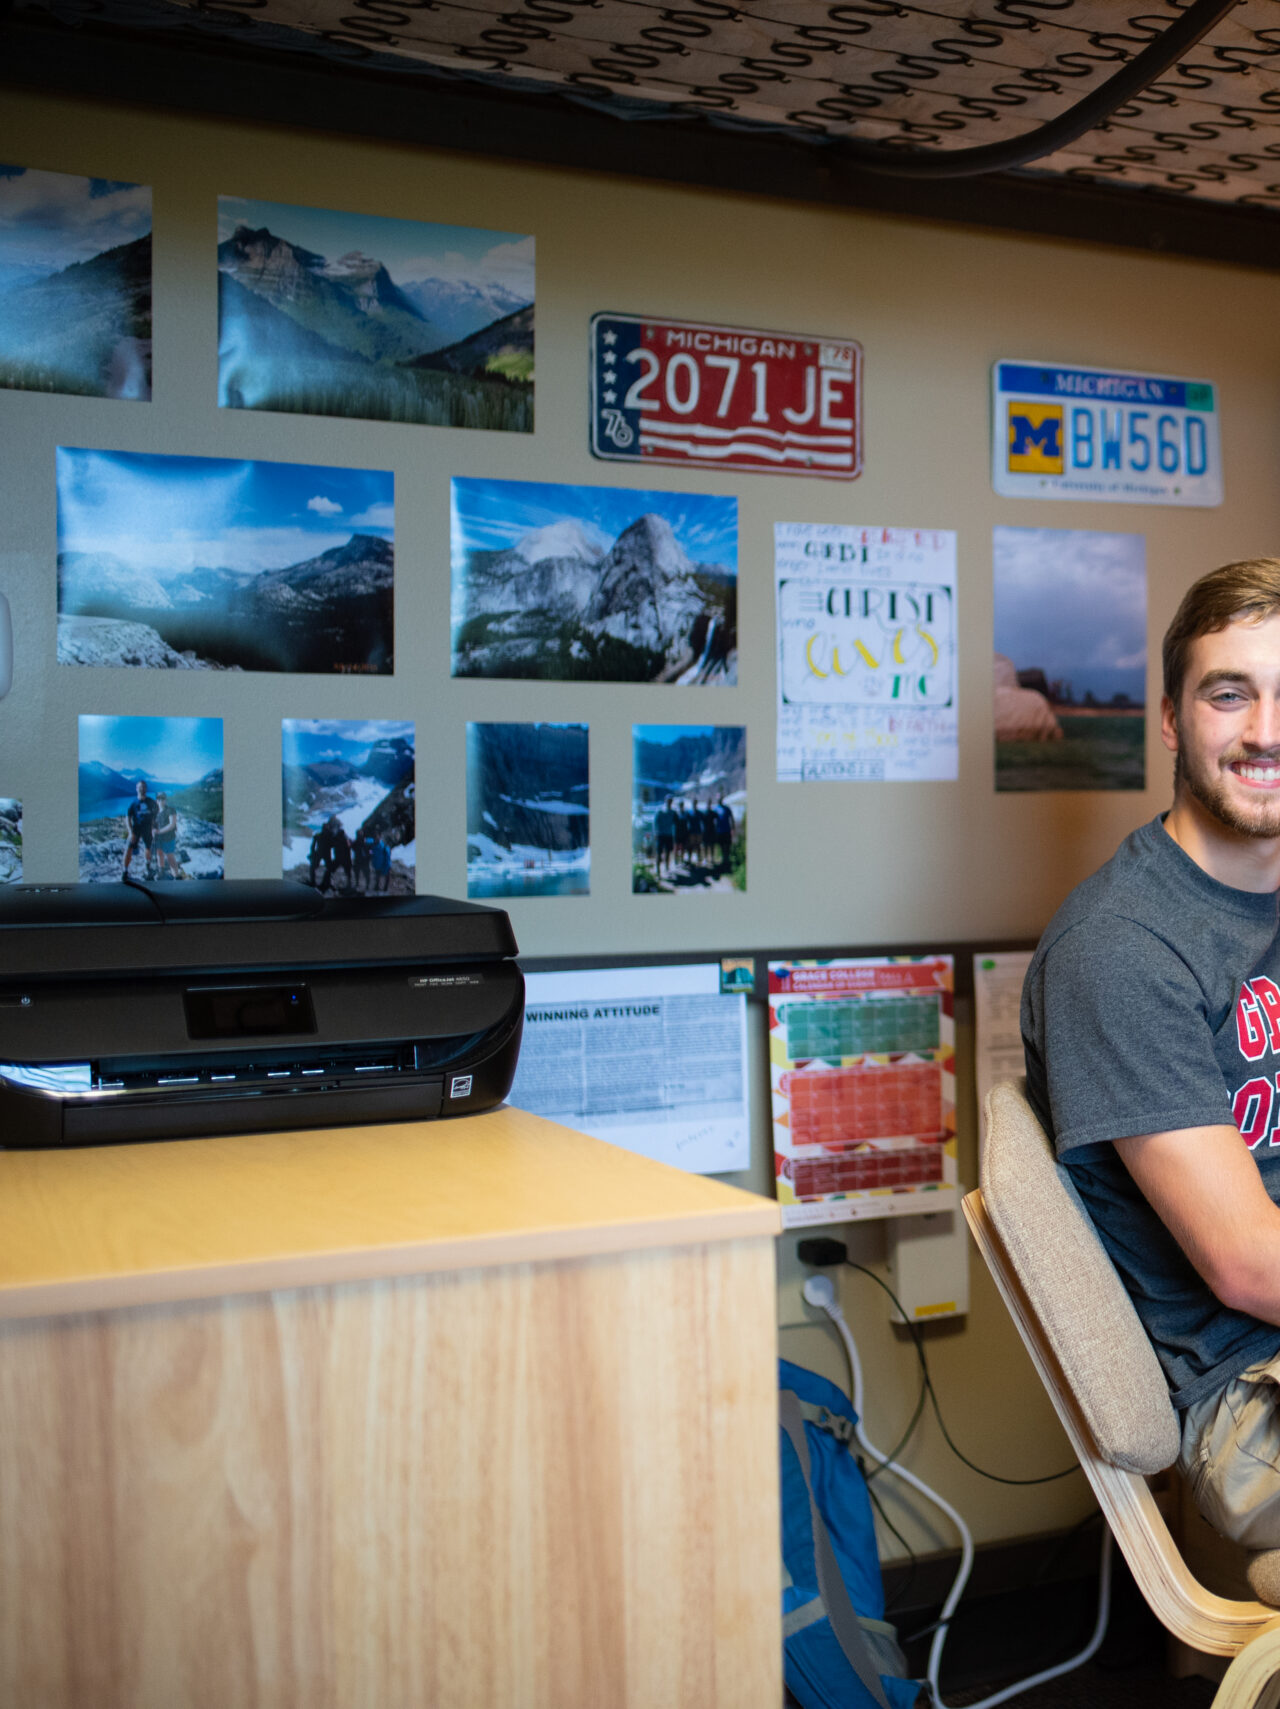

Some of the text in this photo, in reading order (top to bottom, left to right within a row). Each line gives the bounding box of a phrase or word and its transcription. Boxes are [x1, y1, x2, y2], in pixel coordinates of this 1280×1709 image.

[666, 329, 797, 360] MICHIGAN
[624, 347, 853, 430] 2071 JE
[1054, 373, 1165, 400] MICHIGAN
[602, 409, 634, 448] 76
[1010, 415, 1061, 457] M
[792, 970, 828, 981] GRACE
[830, 968, 875, 980] COLLEGE
[525, 1004, 661, 1023] WINNING ATTITUDE
